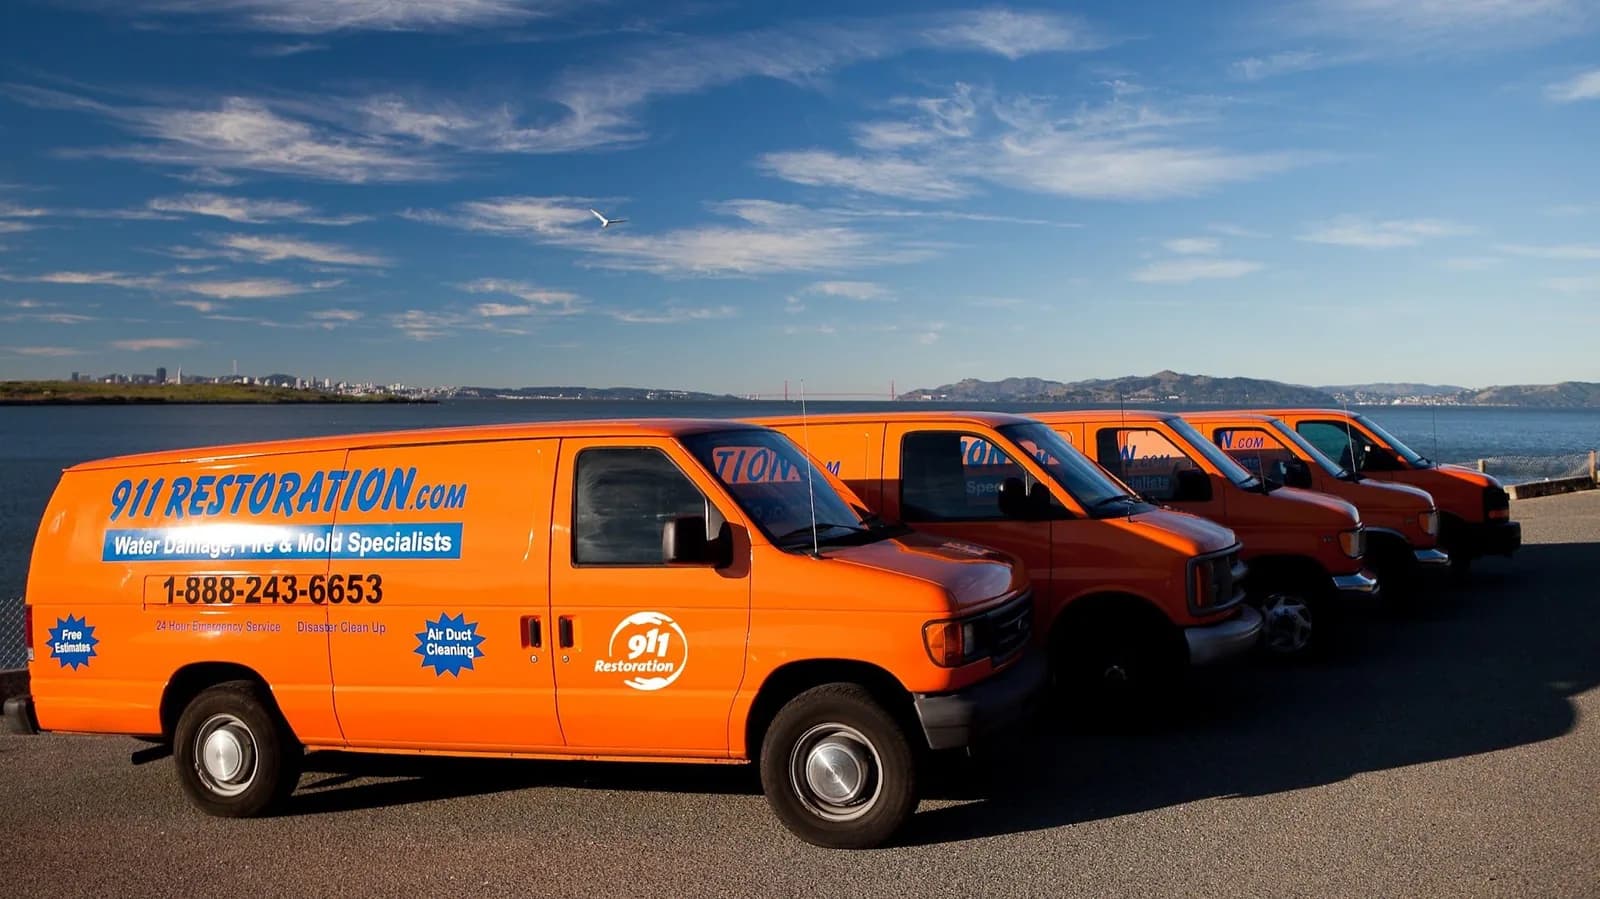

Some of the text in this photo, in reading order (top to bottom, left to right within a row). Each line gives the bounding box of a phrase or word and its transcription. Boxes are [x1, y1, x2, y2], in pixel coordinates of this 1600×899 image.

[110, 478, 165, 521] 911
[114, 536, 160, 555] Water
[279, 536, 292, 553] &
[298, 532, 342, 553] Mold
[348, 531, 453, 557] Specialists
[163, 573, 383, 604] 1-888-243-6653
[156, 620, 166, 631] 24
[169, 620, 190, 632] Hour
[246, 621, 281, 632] Service
[297, 621, 386, 636] Disaster Clean Up
[62, 629, 82, 641] Free
[427, 628, 472, 641] Air Duct
[54, 642, 91, 654] Estimates
[426, 643, 475, 659] Cleaning
[628, 628, 670, 660] 911
[594, 659, 675, 673] Restoration
